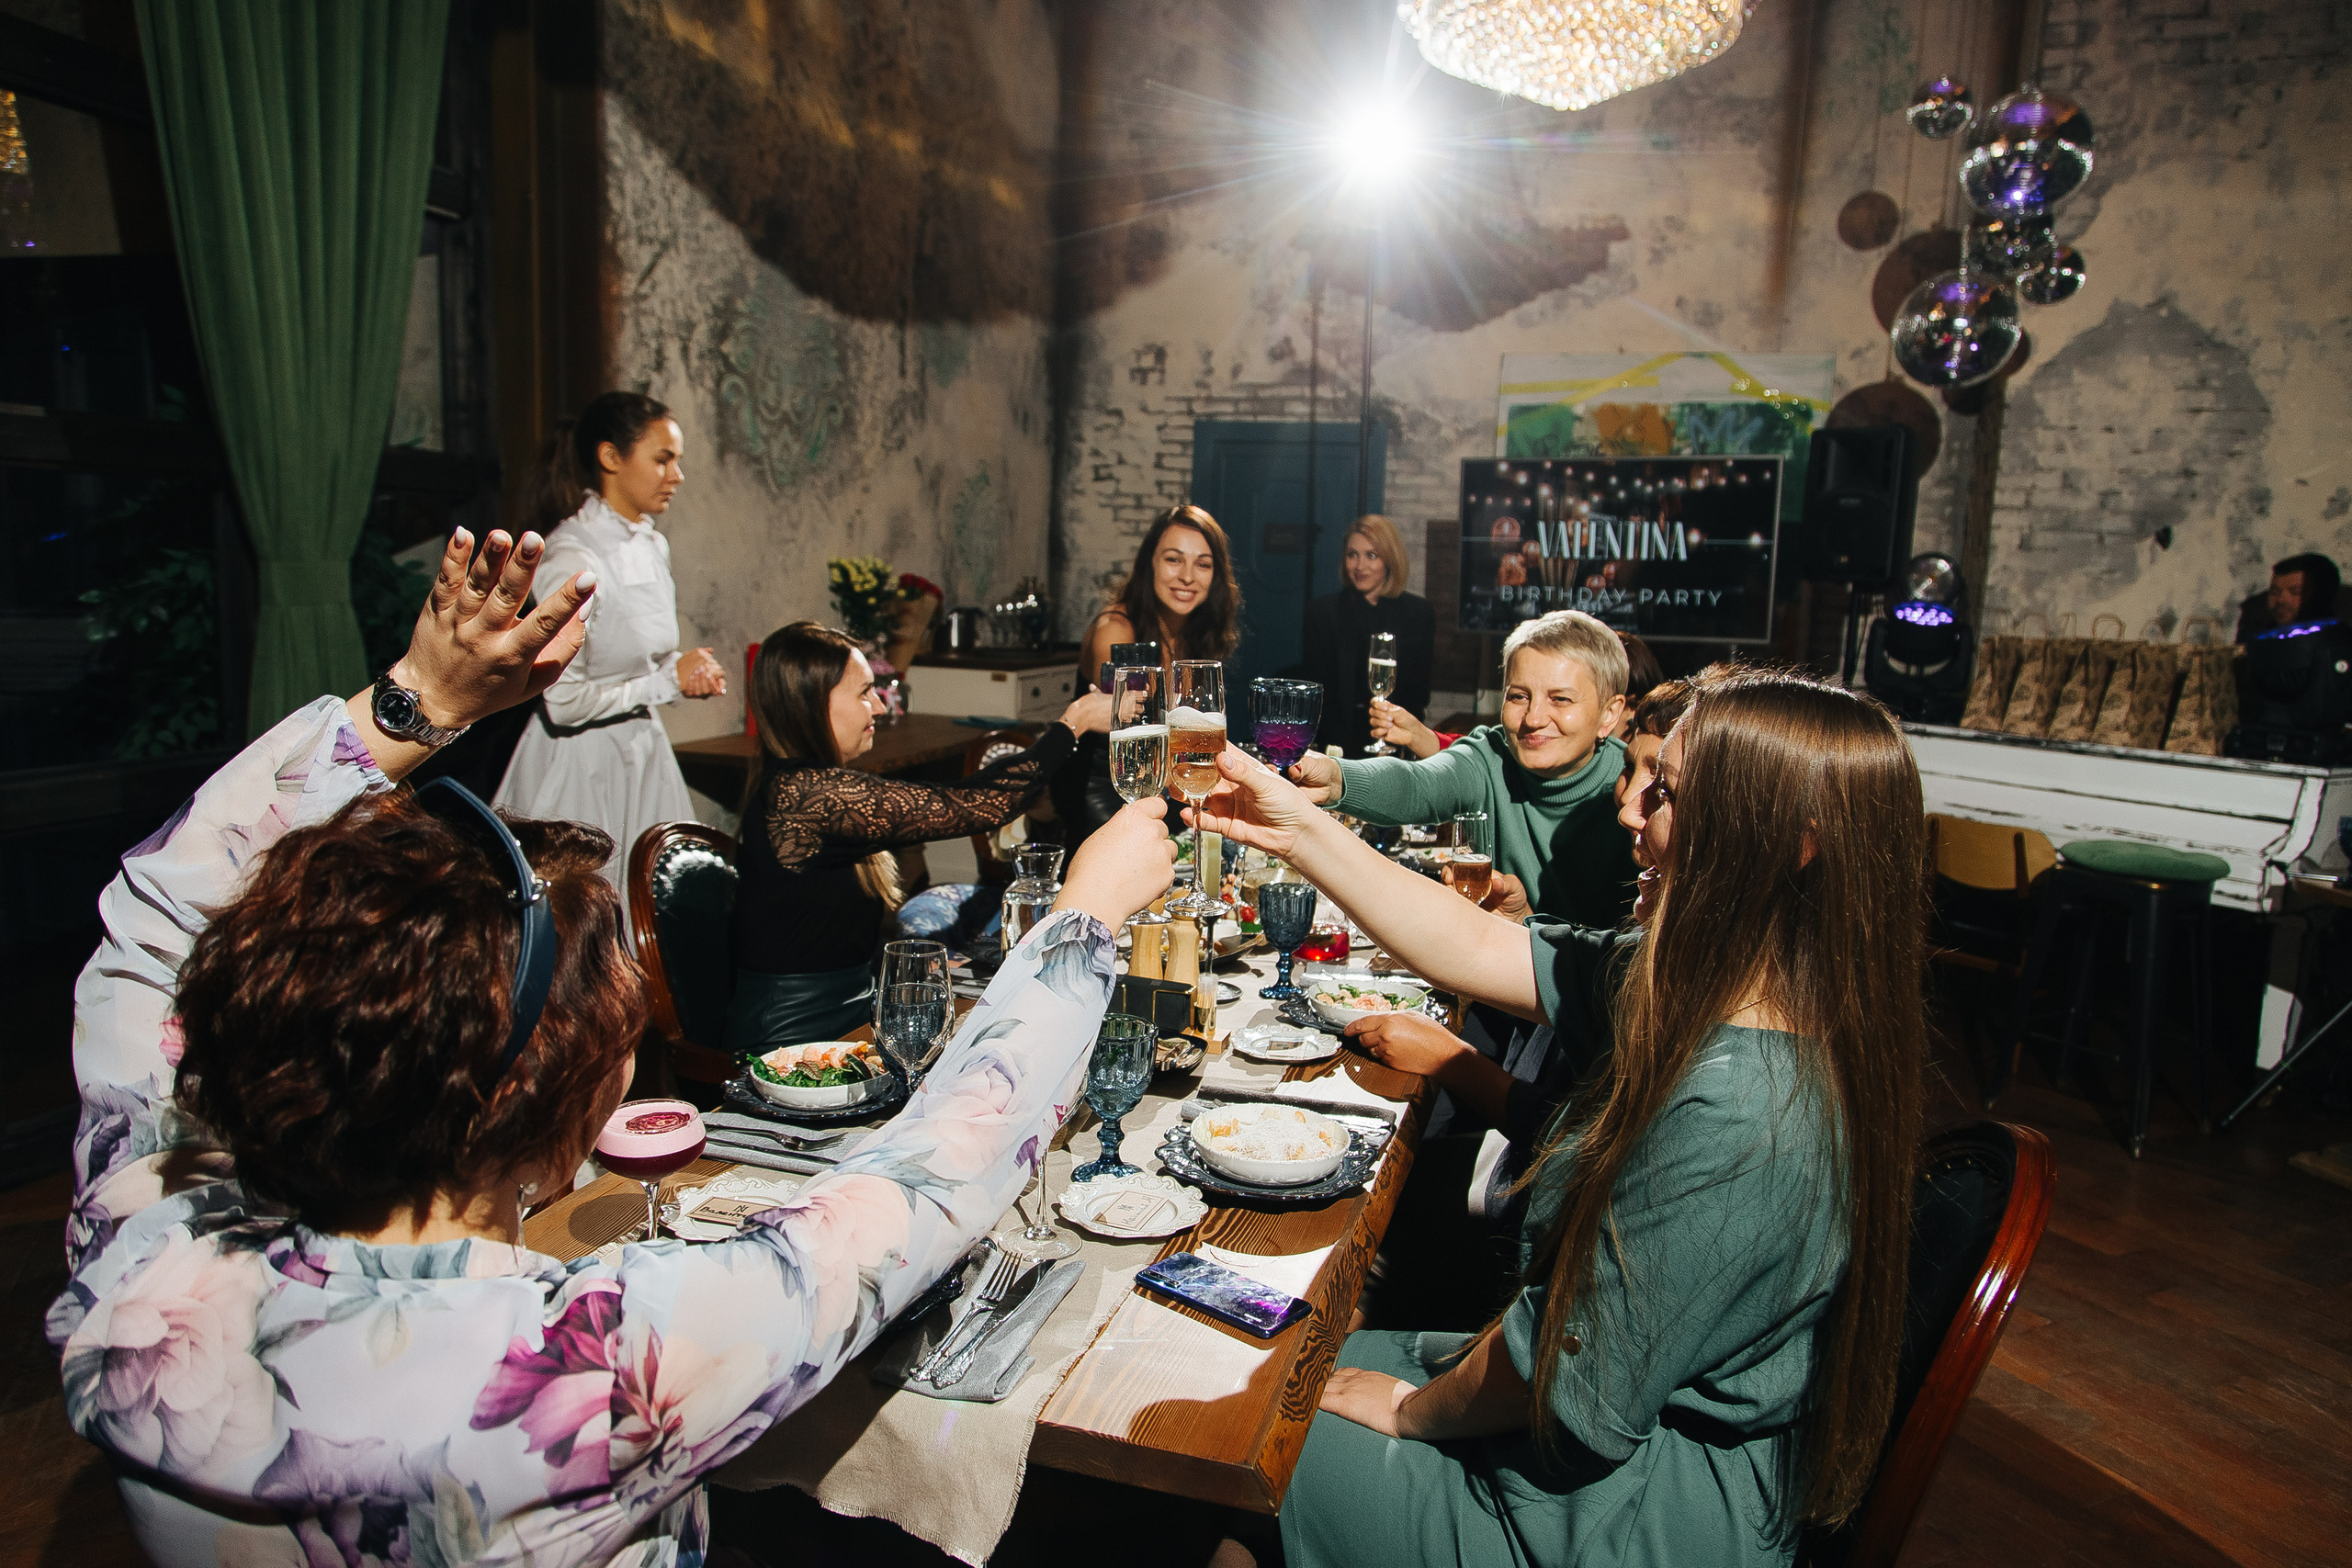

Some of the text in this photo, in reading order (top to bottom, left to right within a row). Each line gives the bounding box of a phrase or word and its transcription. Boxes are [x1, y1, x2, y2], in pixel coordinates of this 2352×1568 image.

[1537, 520, 1688, 561] VALENTINA
[1499, 584, 1723, 606] BIRTHDAY PARTY
